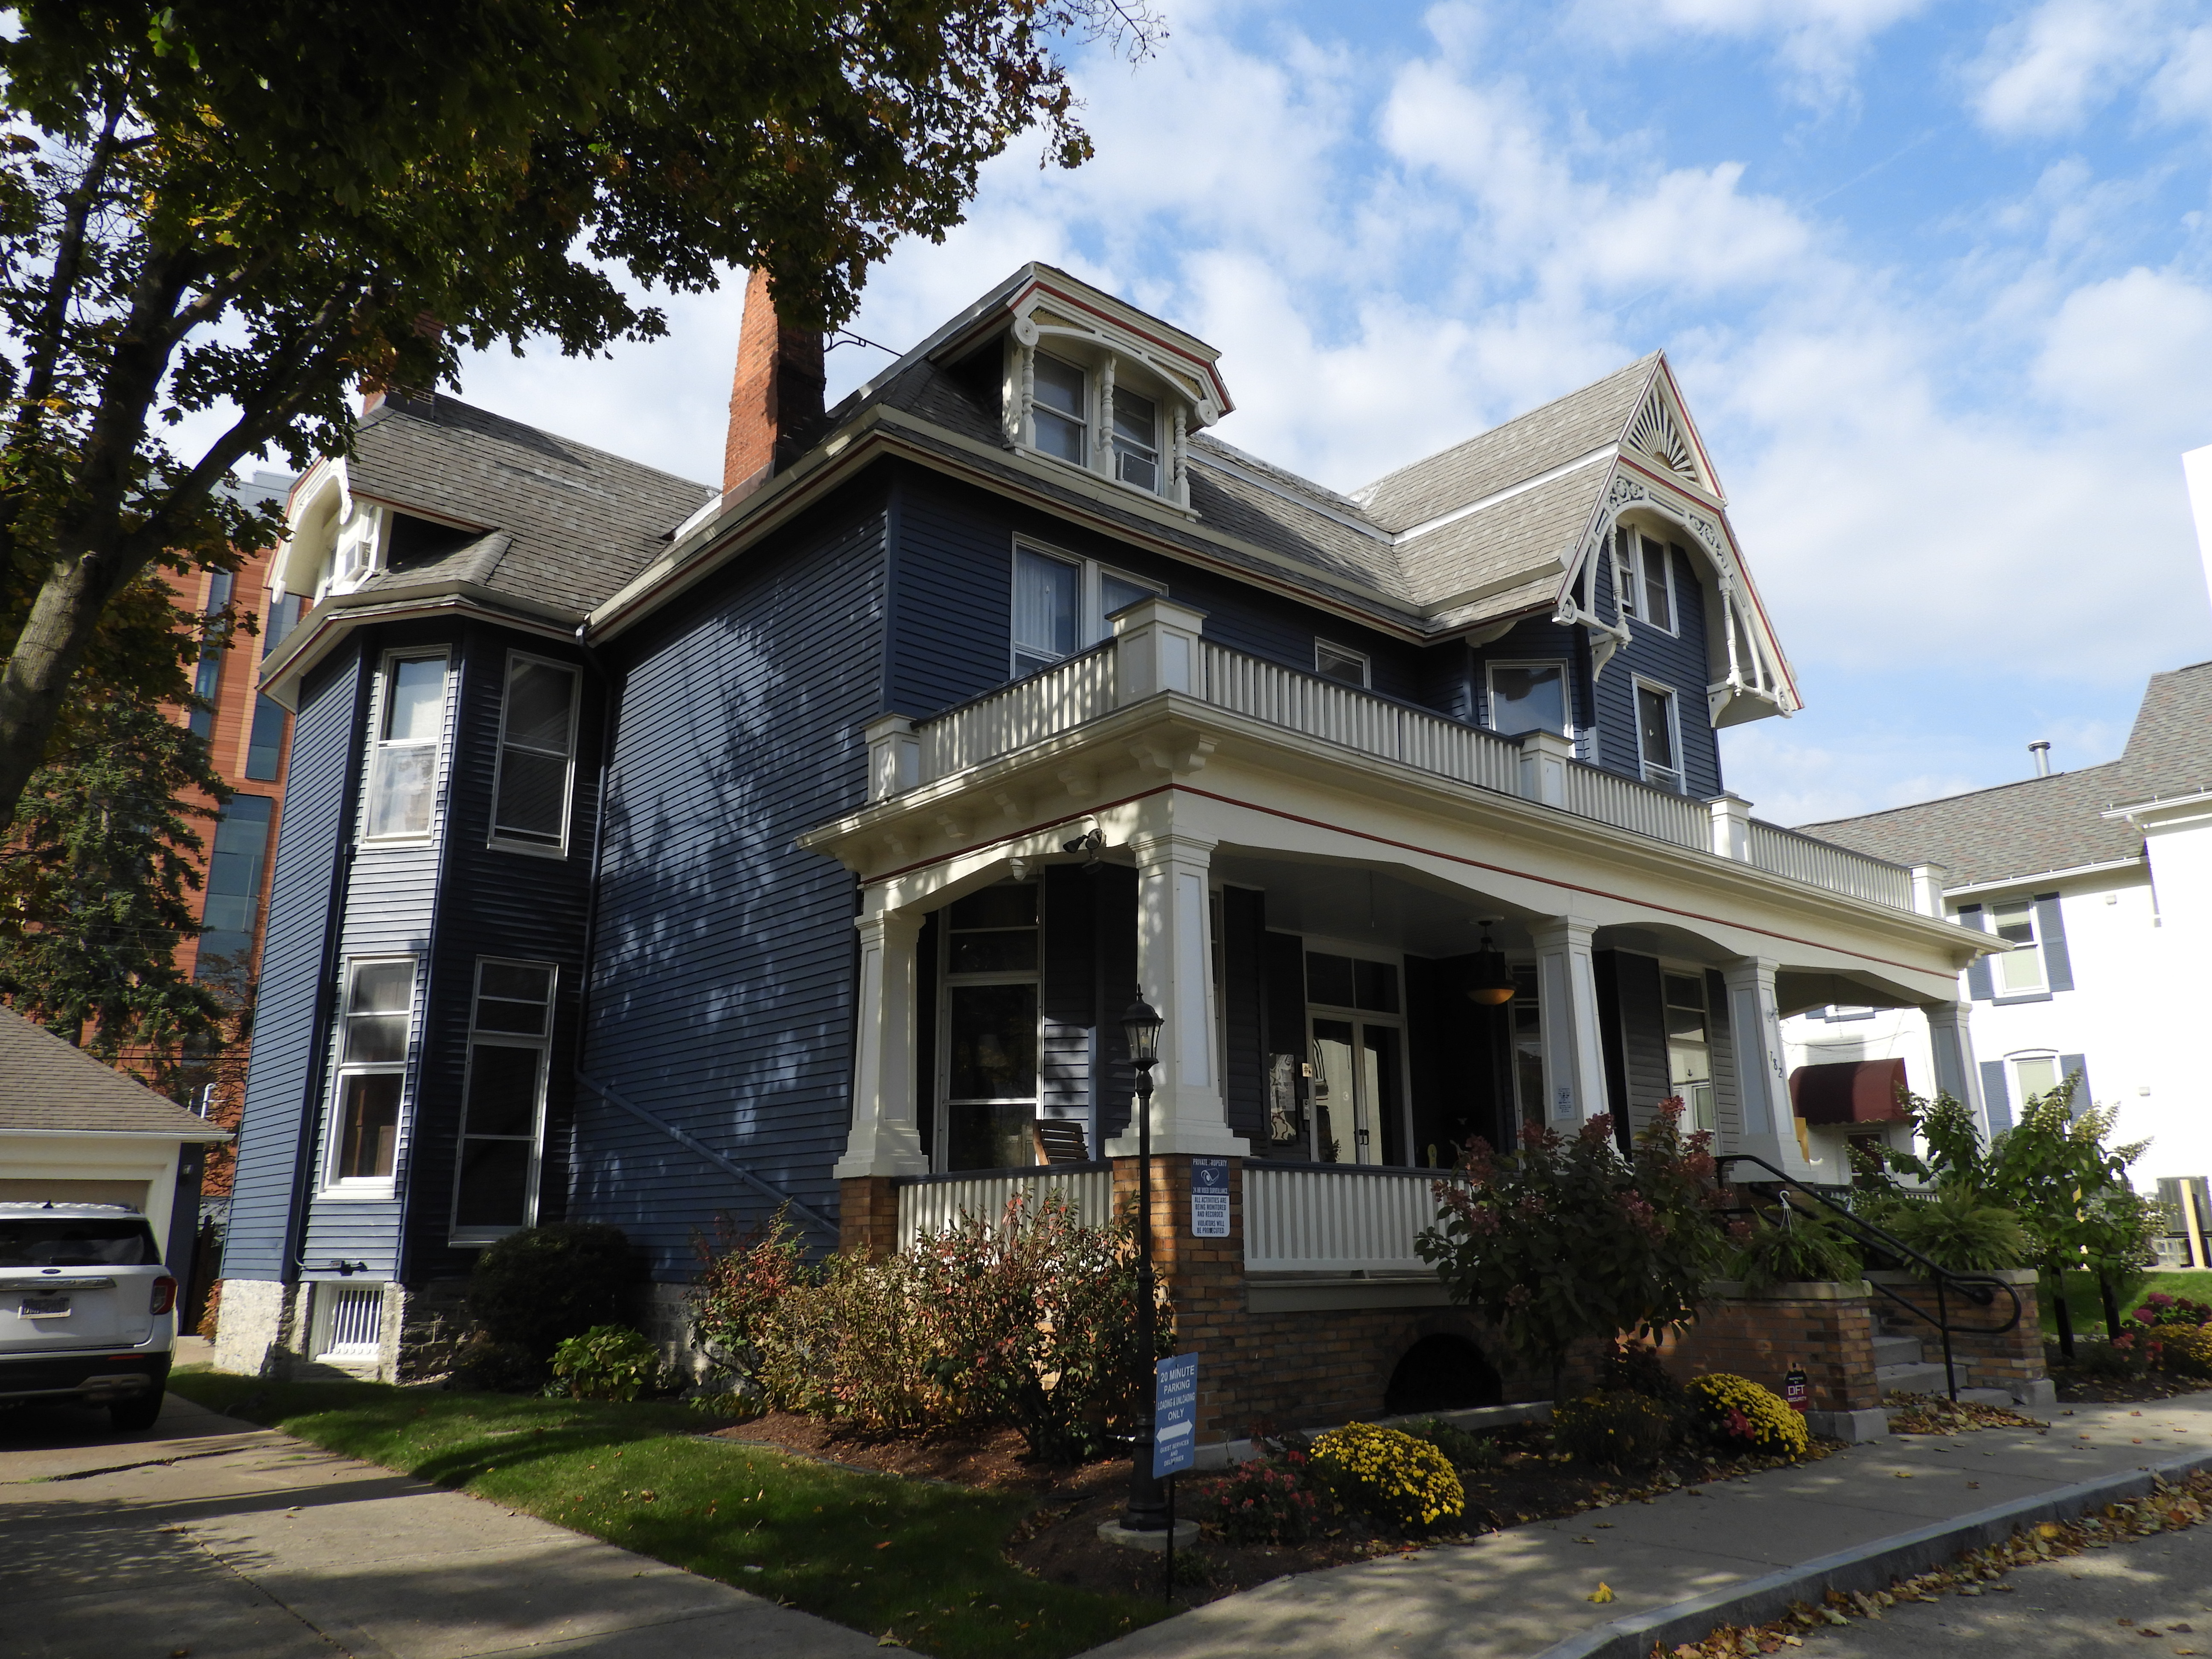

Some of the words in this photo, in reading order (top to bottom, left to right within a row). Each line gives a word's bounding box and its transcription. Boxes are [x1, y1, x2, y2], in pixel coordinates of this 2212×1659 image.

[1770, 1051, 1782, 1078] 182
[1160, 1371, 1168, 1383] 20
[1169, 1365, 1195, 1380] MINUTE
[1164, 1379, 1190, 1395] PARKING
[1158, 1398, 1173, 1411] LOADING
[1176, 1392, 1195, 1406] UNLOADING
[1168, 1407, 1185, 1420] ONLY
[1160, 1444, 1172, 1453] GUEST
[1172, 1439, 1189, 1449] SERVICES
